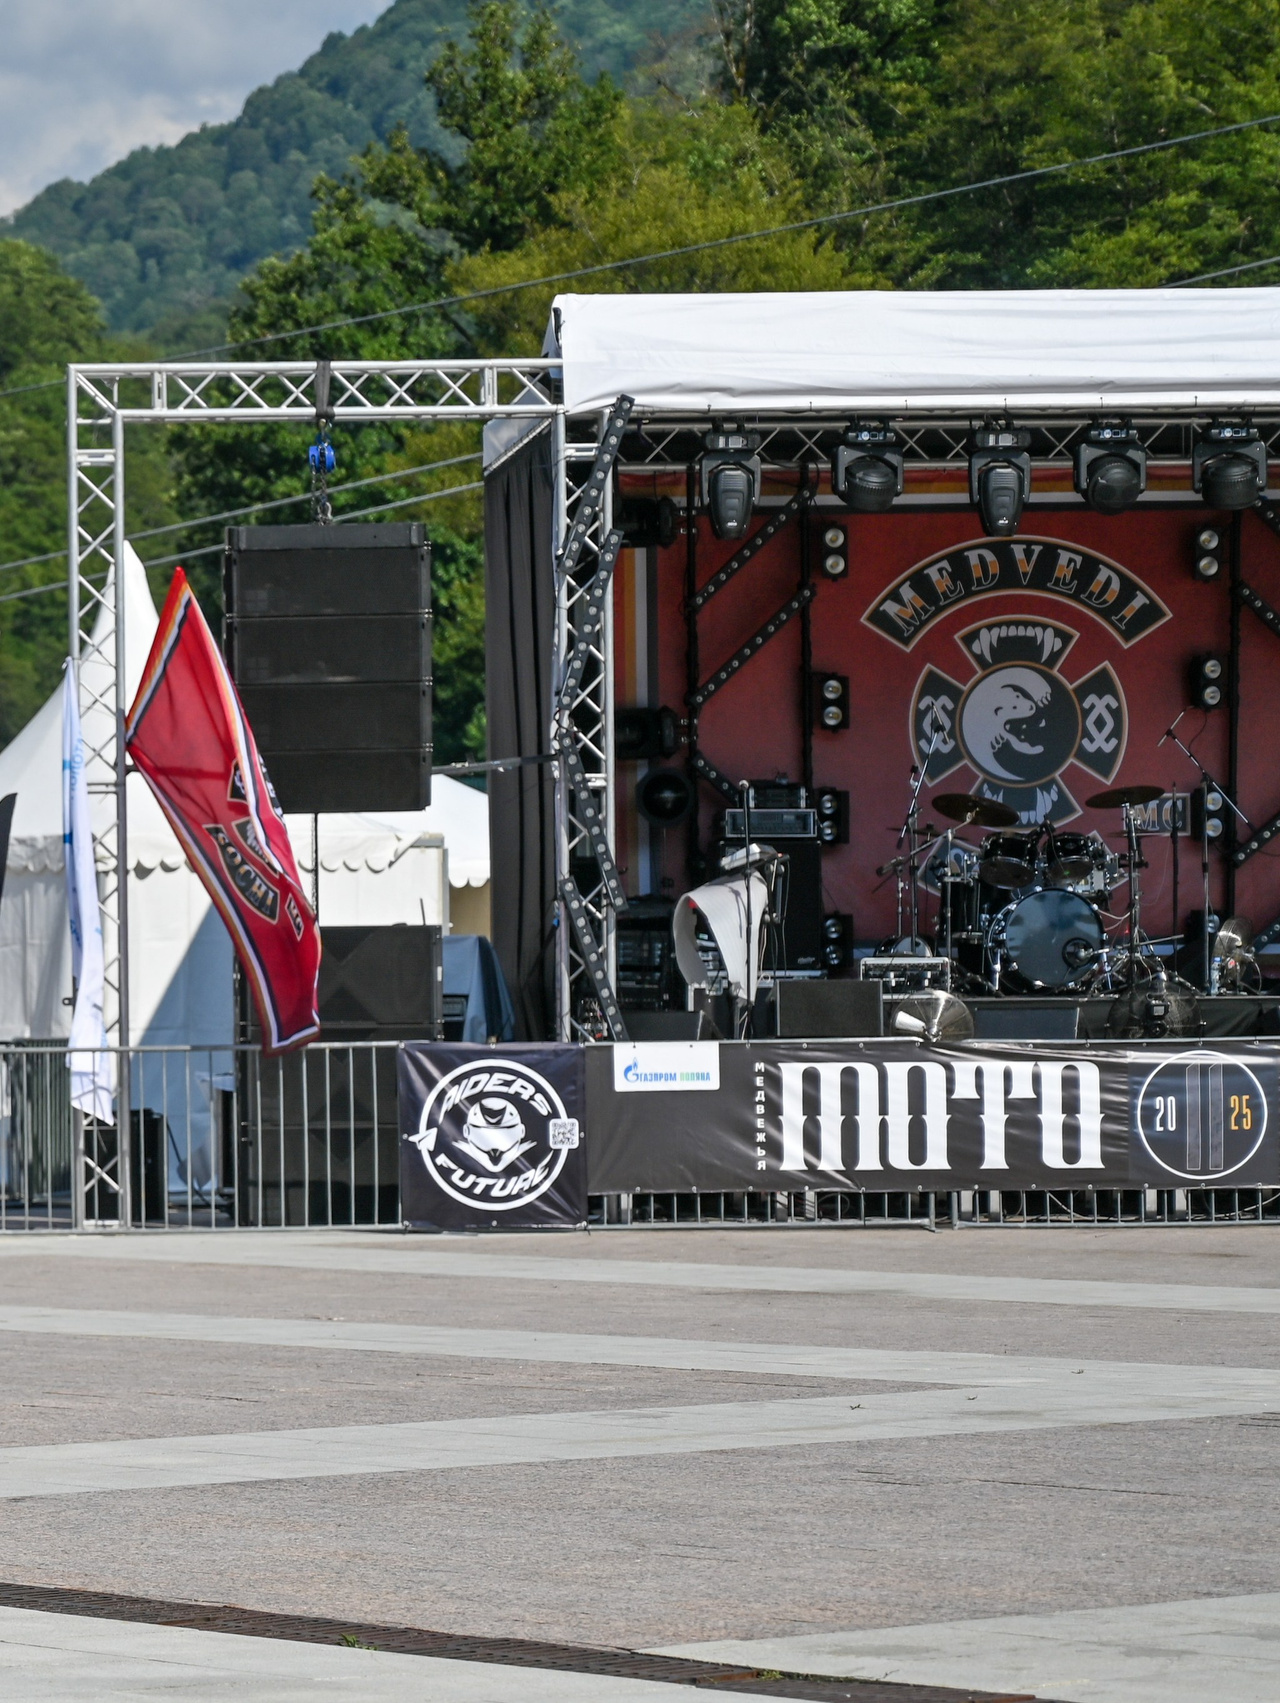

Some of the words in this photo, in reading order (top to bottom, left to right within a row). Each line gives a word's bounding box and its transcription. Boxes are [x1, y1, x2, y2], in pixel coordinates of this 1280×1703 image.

[879, 544, 1150, 636] MEDVEDI
[217, 832, 275, 915] SOCHI
[439, 1073, 553, 1125] RIDERS
[640, 1073, 677, 1082] ГАЗПРОМ
[680, 1072, 710, 1082] ПОЛЯНА
[754, 1062, 767, 1171] МЕДВЕЖЬЯ
[1155, 1096, 1176, 1132] 20
[1230, 1095, 1252, 1130] 25
[435, 1150, 554, 1197] FUTURE
